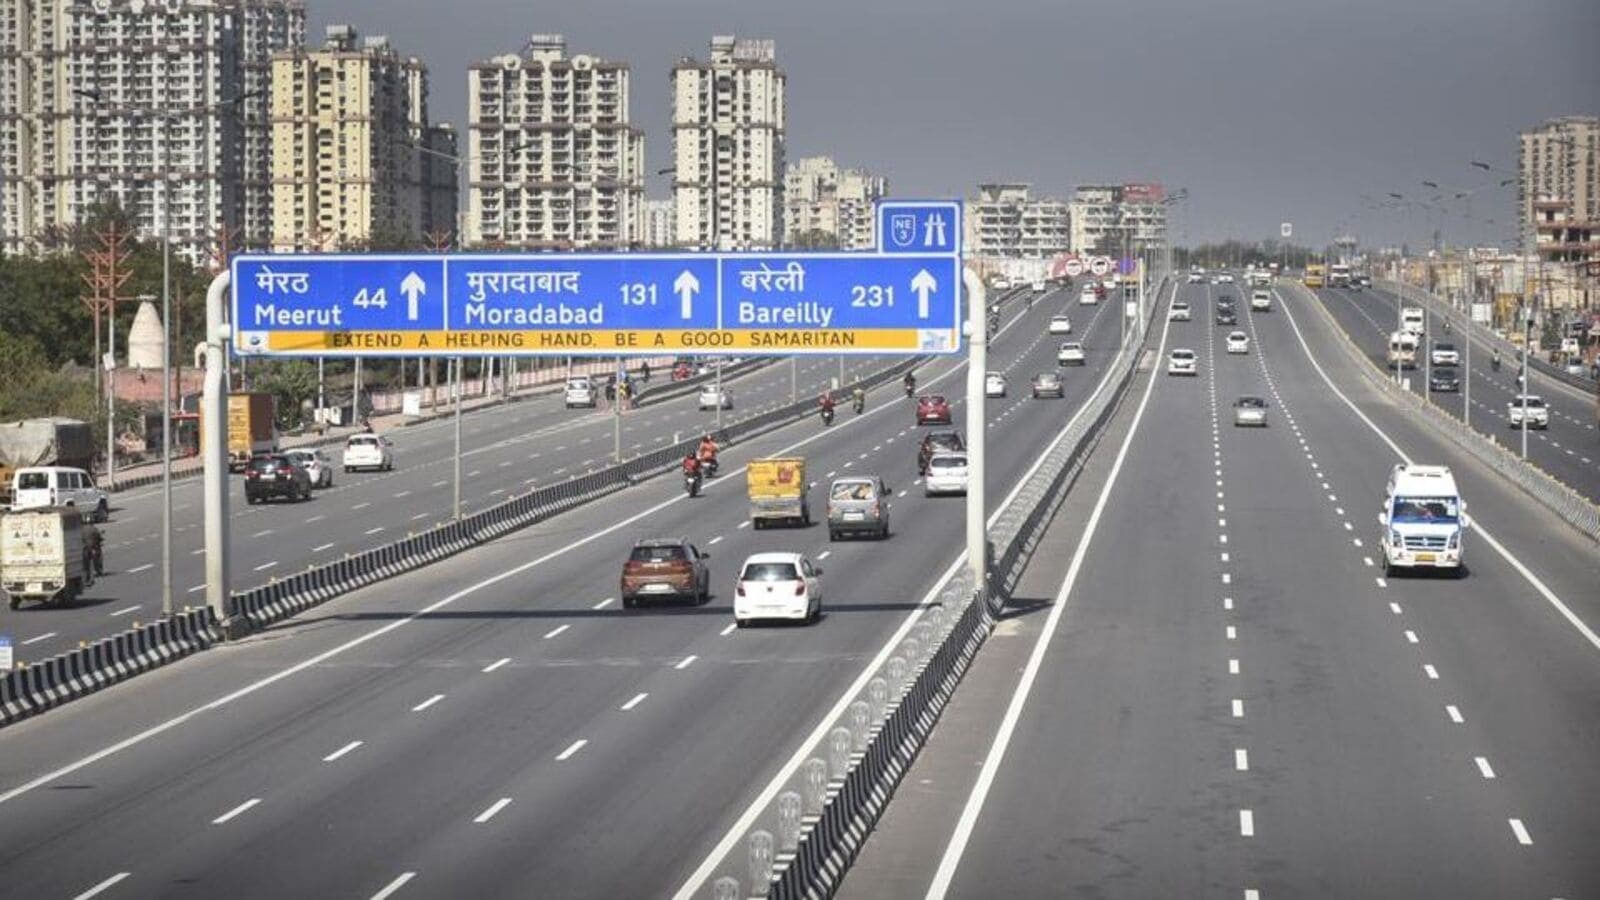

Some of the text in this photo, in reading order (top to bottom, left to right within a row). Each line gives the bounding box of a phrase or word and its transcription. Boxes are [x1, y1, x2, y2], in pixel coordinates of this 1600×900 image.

[895, 219, 912, 229] NE
[900, 230, 907, 240] 3
[255, 265, 309, 294] मेरठ
[467, 271, 580, 302] मुरादाबाद
[740, 261, 806, 292] बरेली
[353, 288, 388, 309] 44
[620, 284, 657, 305] 131
[852, 286, 894, 308] 231
[255, 304, 342, 325] Meerut
[466, 303, 603, 326] Moradabad
[739, 302, 833, 326] Bareilly
[334, 333, 401, 347] EXTEND
[418, 333, 429, 347] A
[447, 333, 523, 347] HELPING
[615, 332, 637, 346] BE
[654, 332, 664, 346] A
[681, 332, 733, 346] GOOD
[750, 332, 854, 346] SAMARITAN
